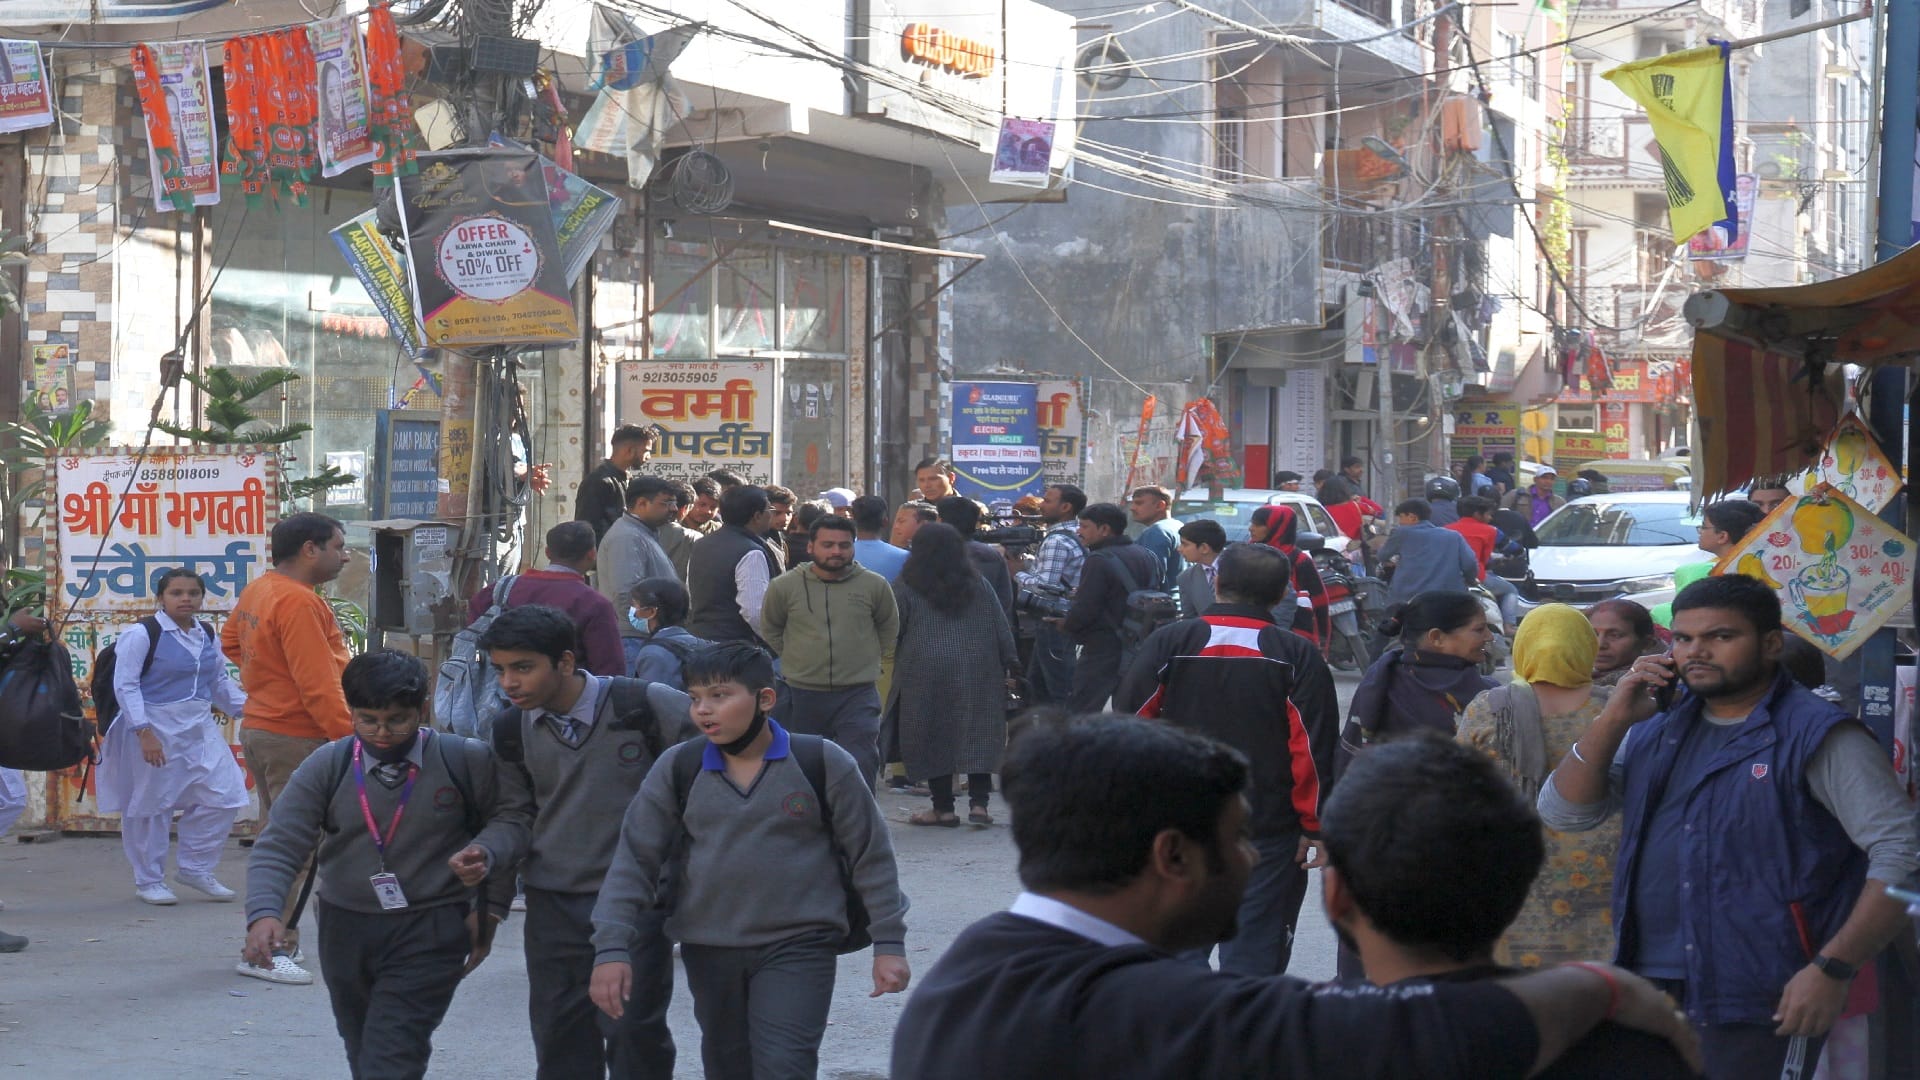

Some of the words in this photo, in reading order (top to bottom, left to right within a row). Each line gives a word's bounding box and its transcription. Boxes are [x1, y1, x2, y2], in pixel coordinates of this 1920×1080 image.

[565, 194, 600, 232] SCHOOL
[457, 223, 510, 243] OFFER
[348, 228, 383, 271] AARYAN
[456, 241, 483, 250] KARWA
[485, 239, 517, 248] CHAUTH
[476, 248, 508, 258] DIWALI
[456, 258, 492, 276] 50%
[496, 254, 523, 272] OFF
[643, 372, 718, 384] 9213055905
[640, 379, 756, 421] वर्मा
[982, 394, 1019, 402] GLADGURU
[1458, 412, 1476, 425] R.
[1485, 412, 1503, 425] R.
[991, 435, 1023, 443] VEHICLES
[1565, 438, 1594, 449] R.R.
[141, 468, 220, 481] 8588018019
[972, 466, 989, 475] Free
[63, 481, 113, 537] श्री
[119, 482, 160, 537] माँ
[165, 477, 267, 537] भगवती
[1849, 544, 1879, 561] 30/-
[1771, 554, 1801, 572] 20/-
[1880, 561, 1910, 580] 40/-
